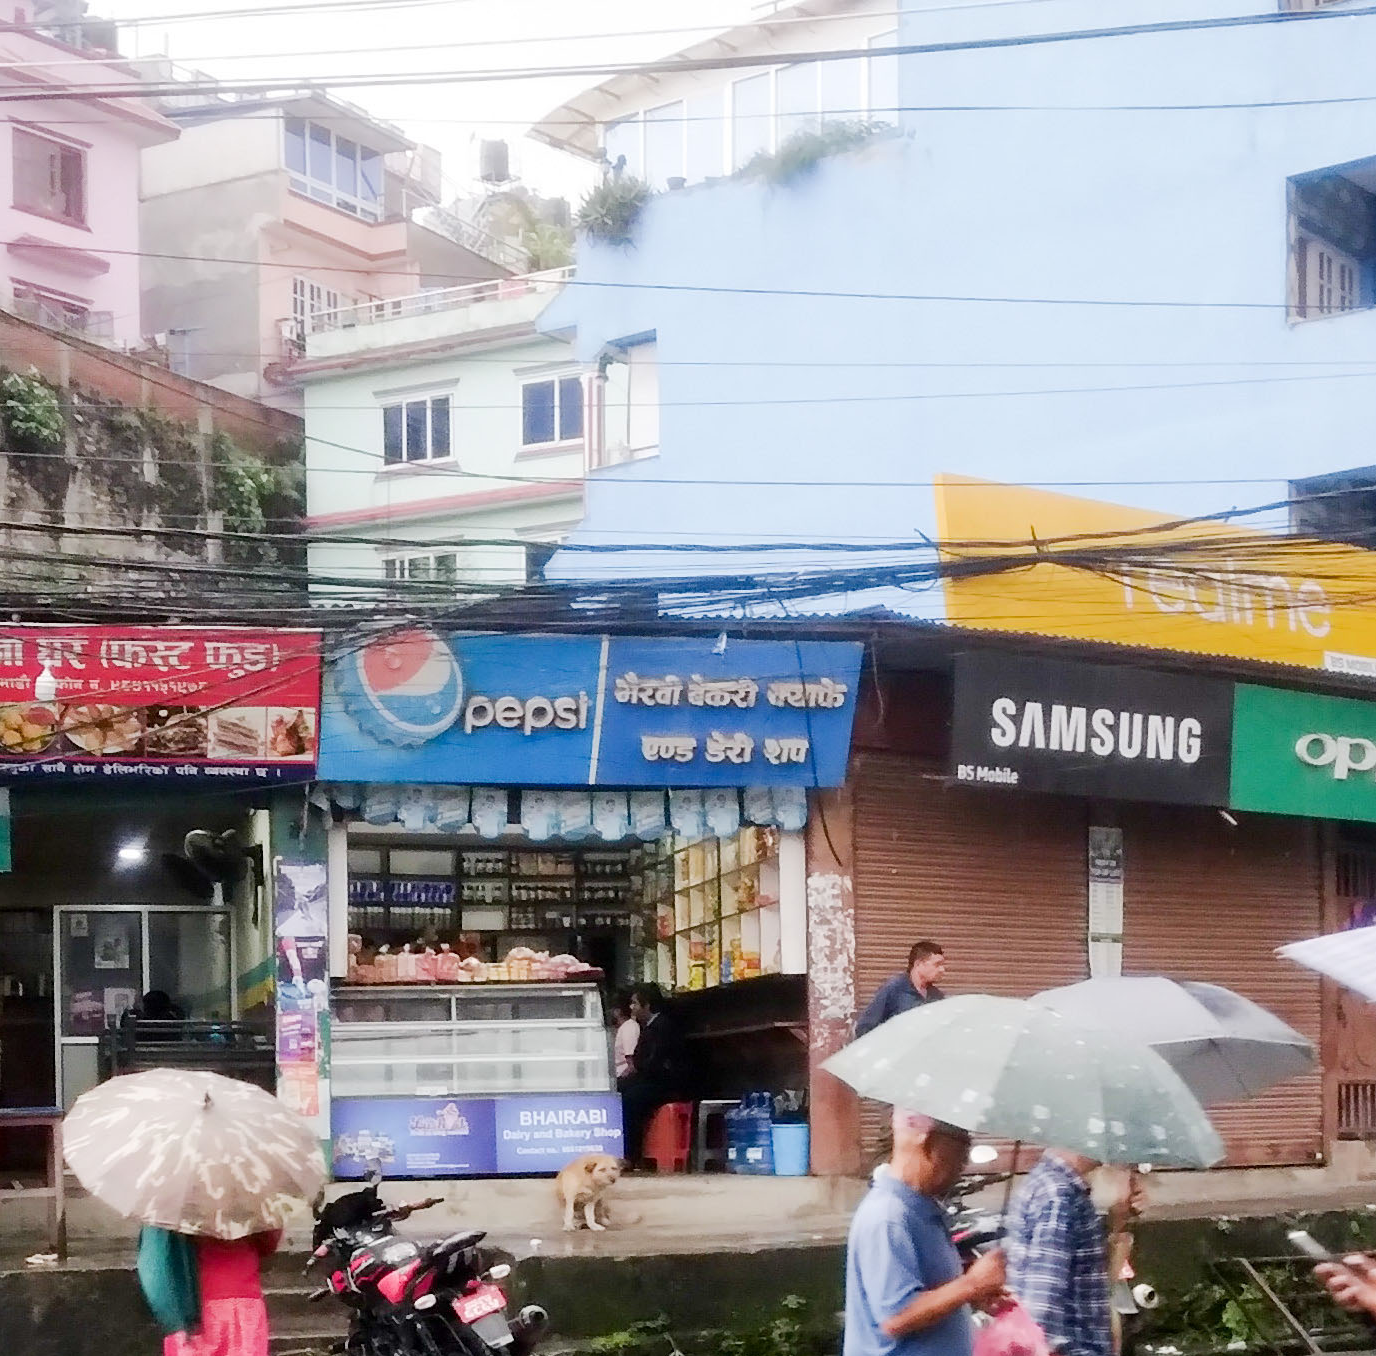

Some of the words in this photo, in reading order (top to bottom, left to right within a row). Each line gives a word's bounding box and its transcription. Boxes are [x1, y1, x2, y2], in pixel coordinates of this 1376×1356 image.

[464, 690, 589, 735] pepsi
[991, 697, 1202, 764] SAMSUNG
[957, 764, 975, 780] BS
[976, 766, 1019, 784] Mobile
[519, 1108, 607, 1126] BHAIRABI
[593, 1126, 622, 1139] Shop
